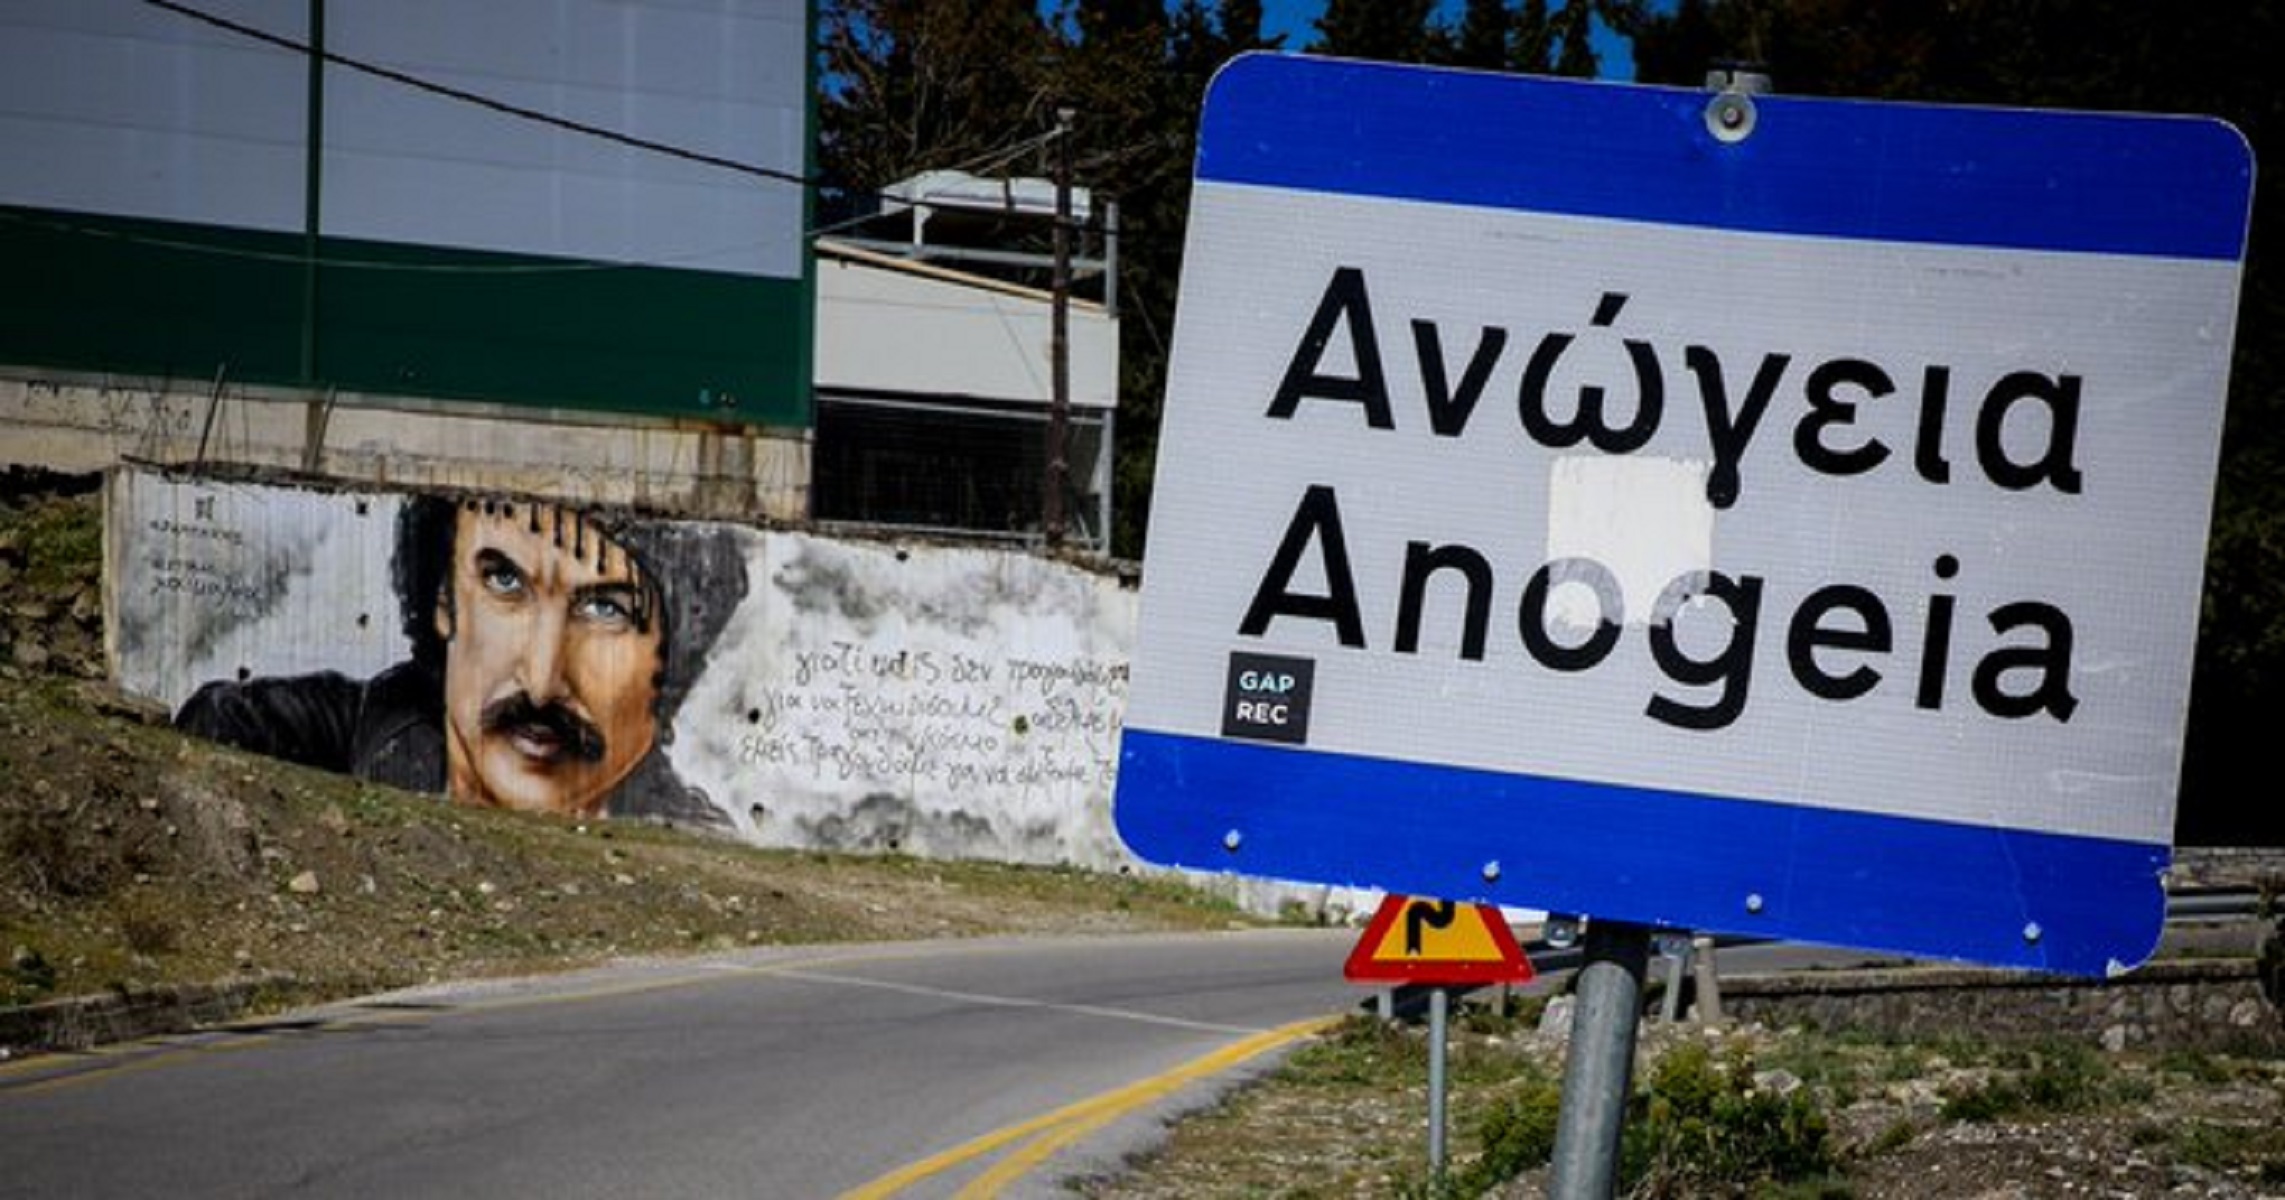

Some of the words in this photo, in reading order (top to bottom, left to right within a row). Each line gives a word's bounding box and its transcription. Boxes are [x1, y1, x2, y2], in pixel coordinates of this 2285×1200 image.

[1267, 267, 2082, 509] Ανώγεια
[1239, 485, 2078, 730] Anogeia
[1236, 702, 1288, 726] REC
[1239, 670, 1295, 693] GAP
